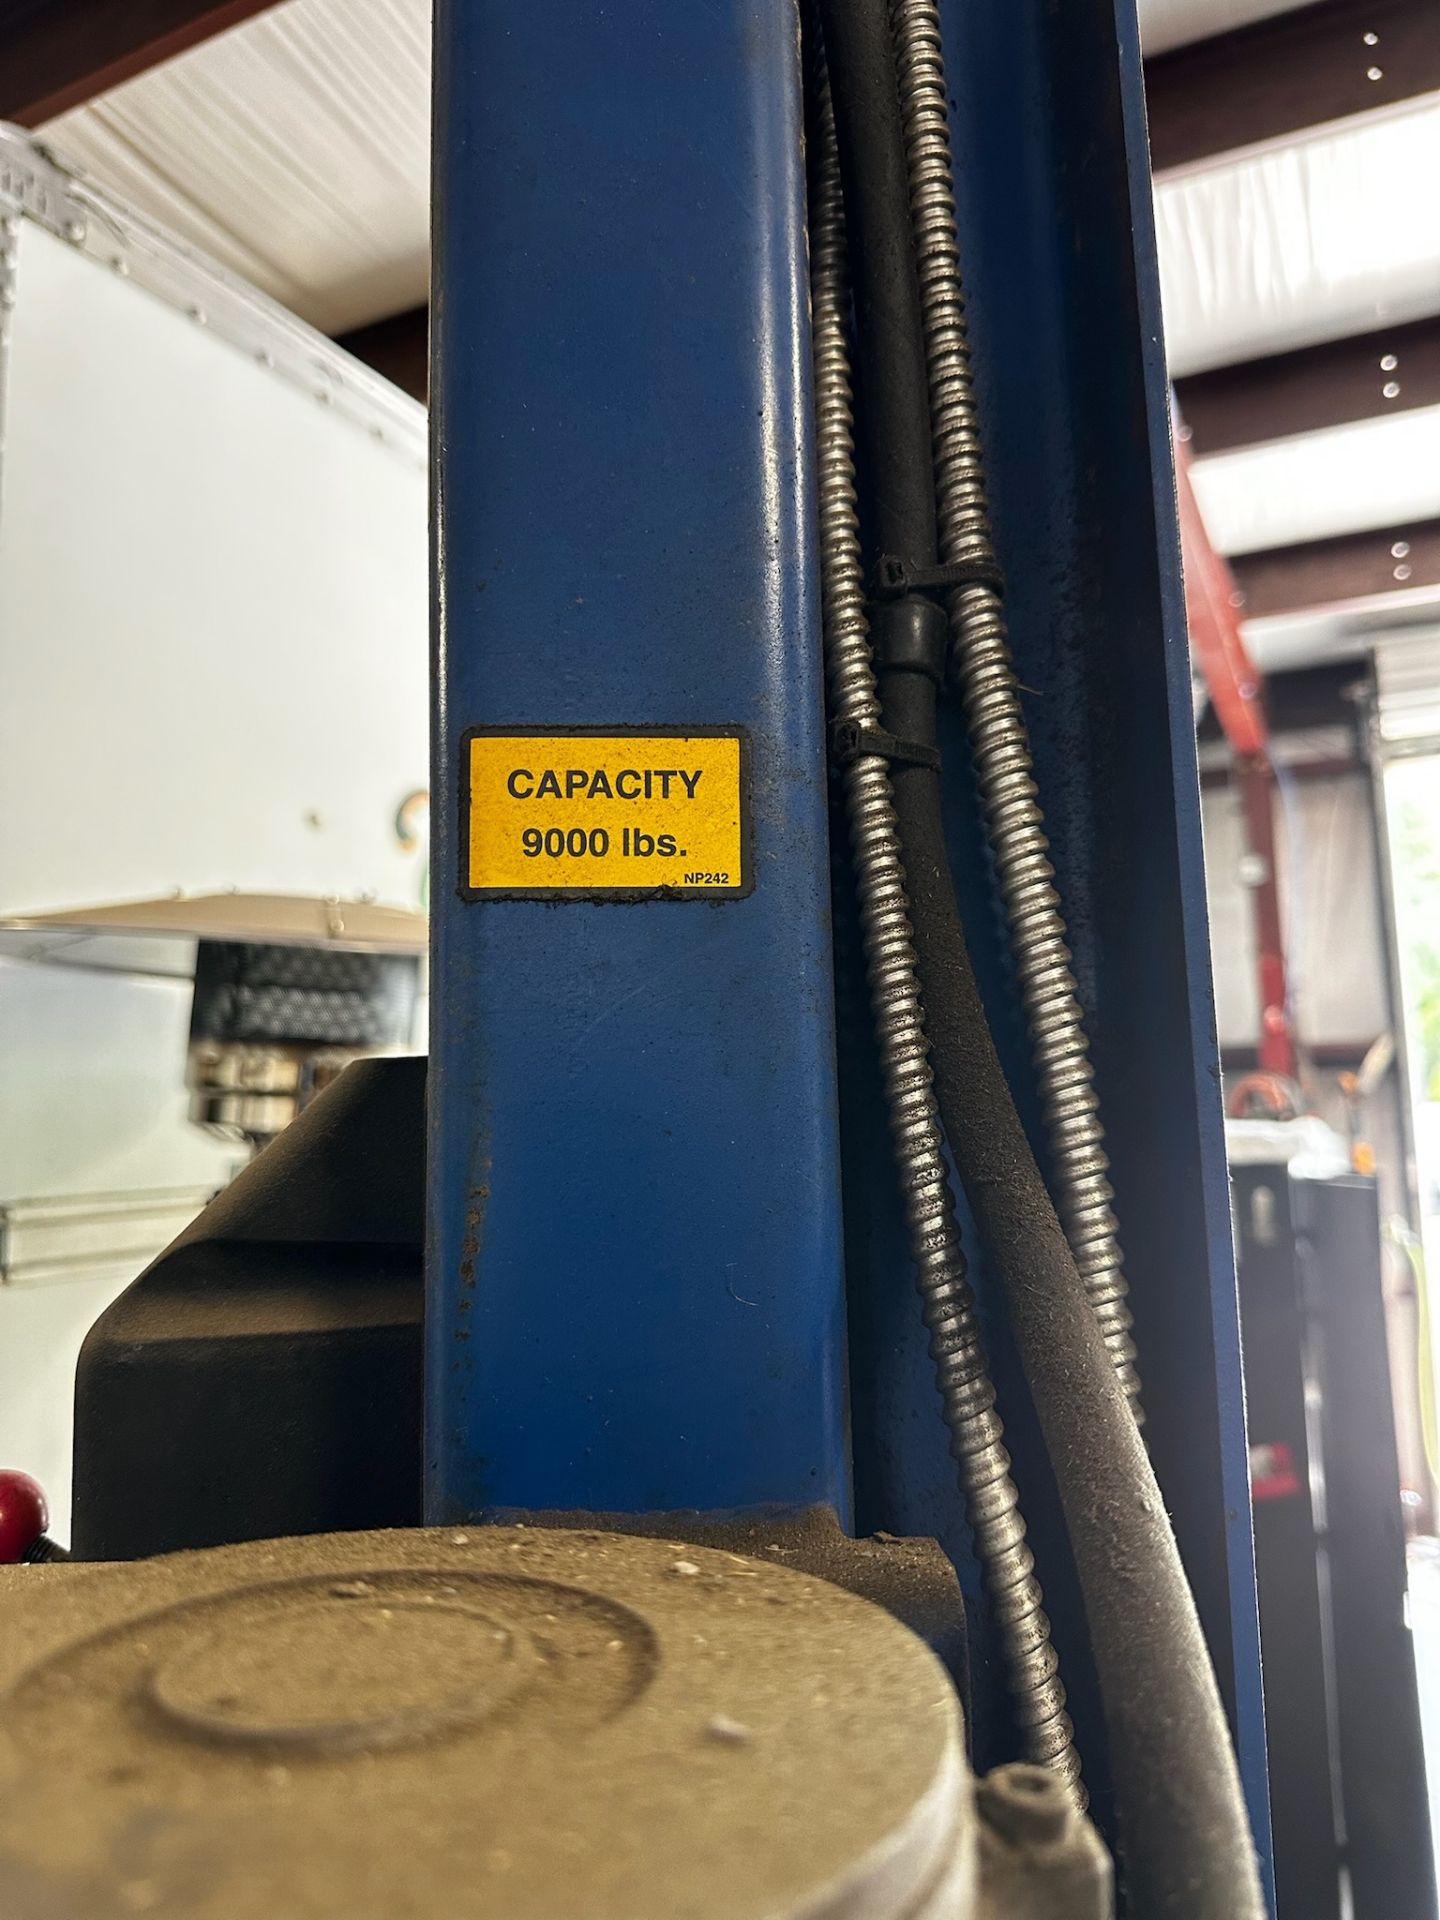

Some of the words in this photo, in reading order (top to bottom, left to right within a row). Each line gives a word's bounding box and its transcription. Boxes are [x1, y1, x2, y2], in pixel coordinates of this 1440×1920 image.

[507, 769, 703, 799] CAPACITY
[522, 828, 609, 857] 9000
[622, 828, 688, 857] lbs.
[684, 872, 729, 885] NP242
